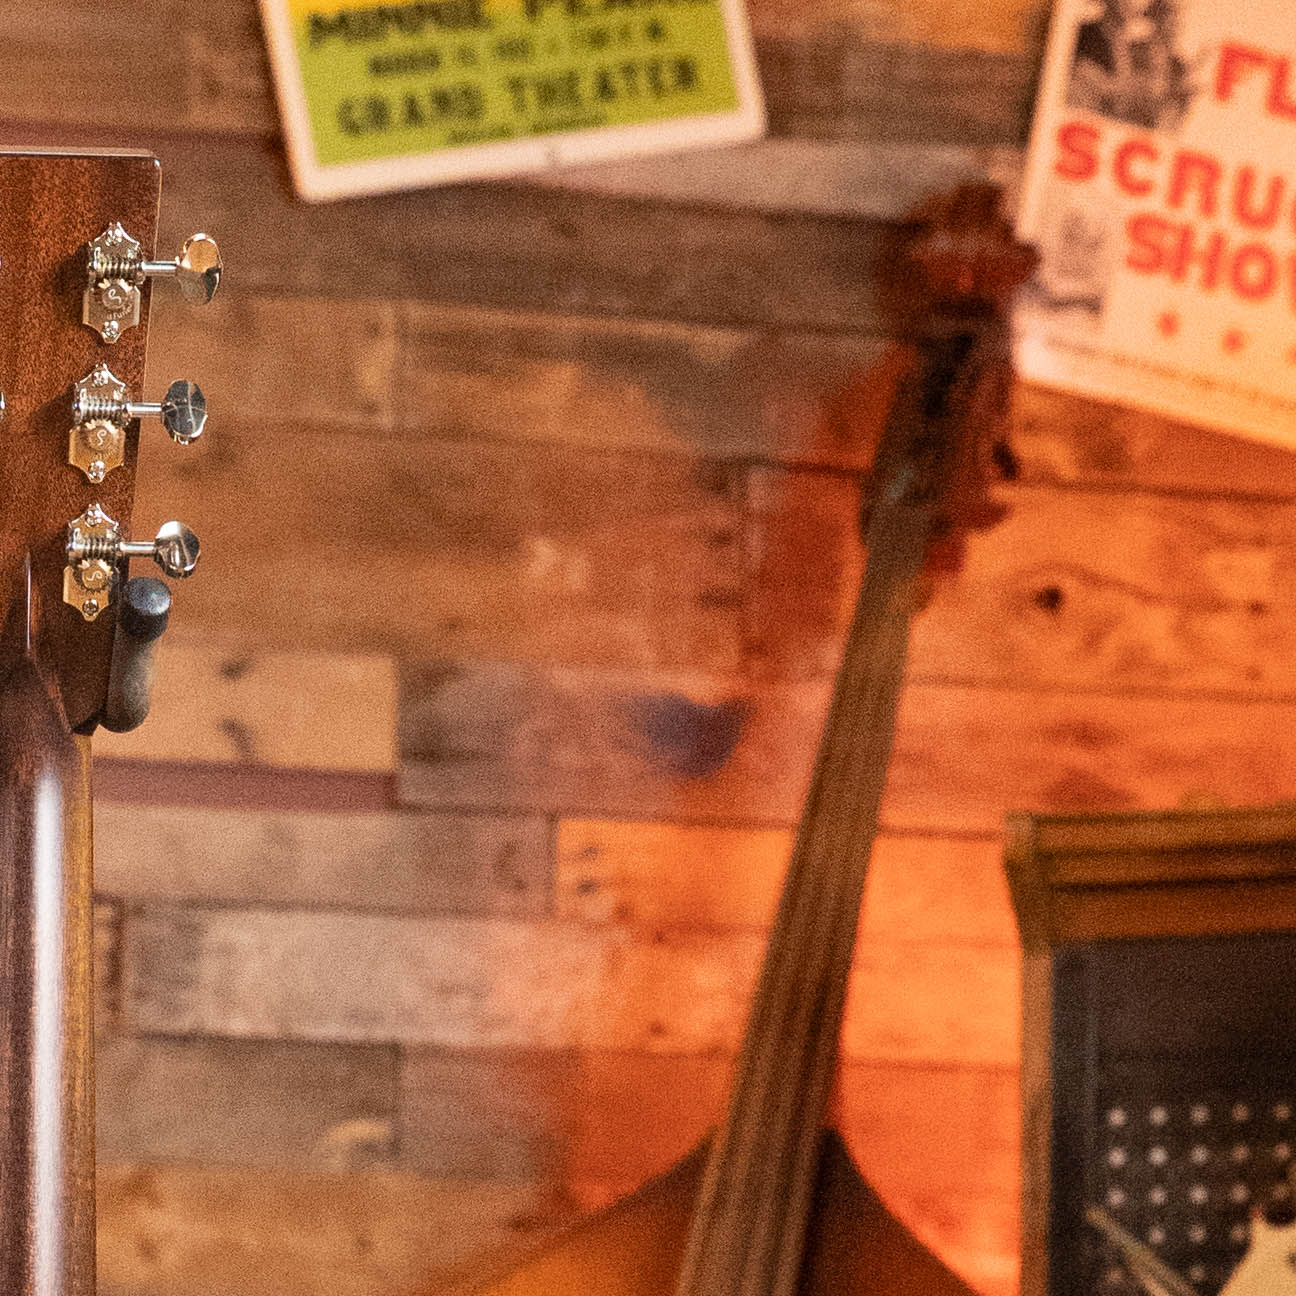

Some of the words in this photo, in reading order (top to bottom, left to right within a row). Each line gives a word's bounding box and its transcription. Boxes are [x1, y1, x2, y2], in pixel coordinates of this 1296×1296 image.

[337, 82, 485, 137] GRAND
[506, 57, 700, 113] THEATER
[1054, 121, 1296, 232] SCRU
[1125, 212, 1296, 312] SHO
